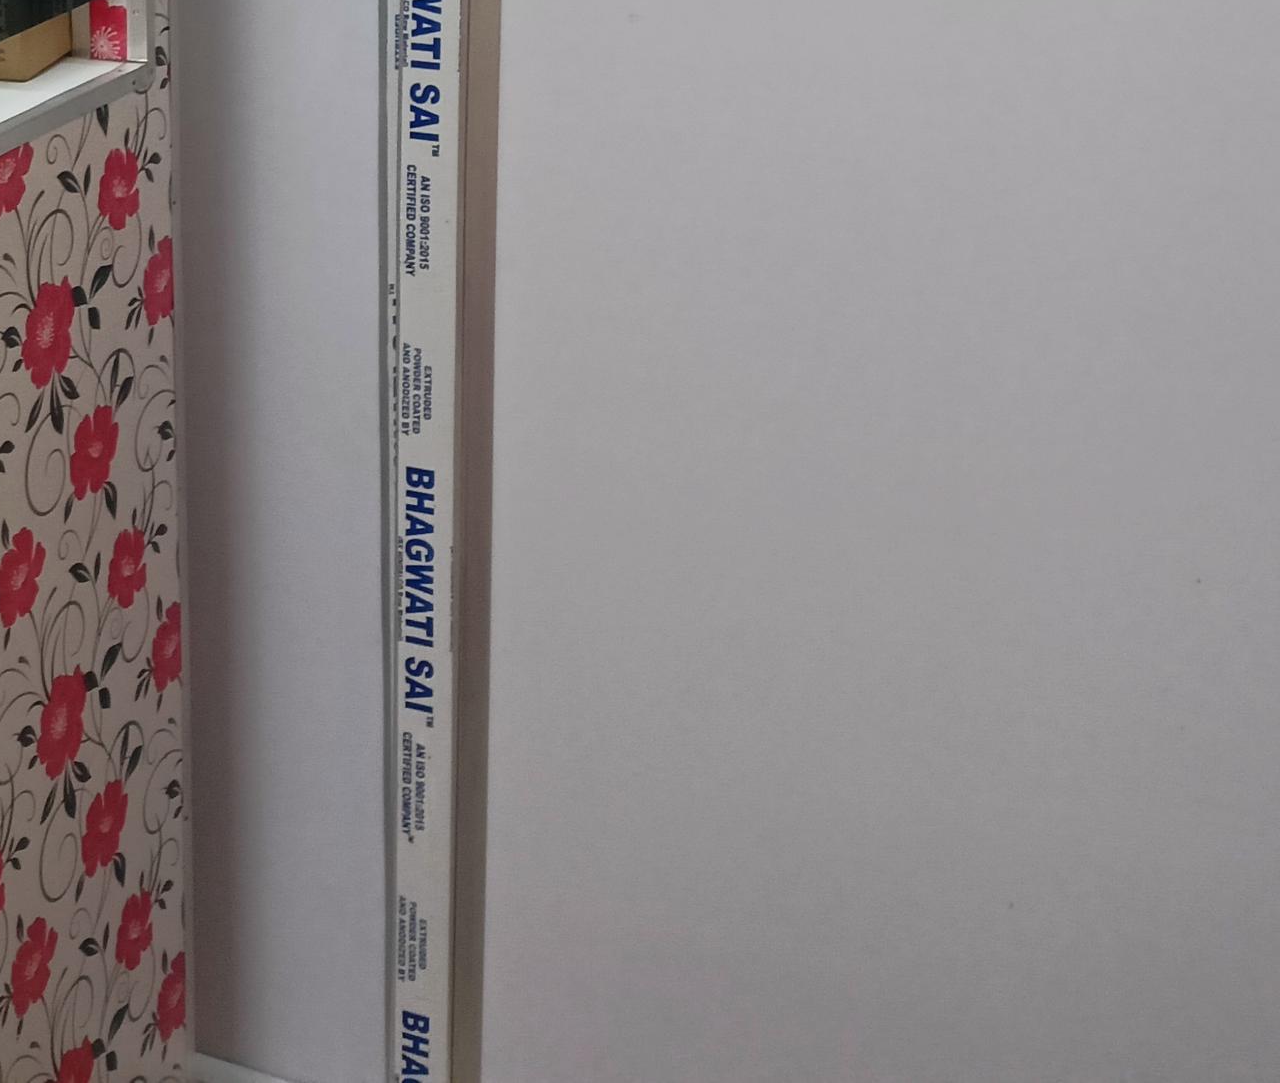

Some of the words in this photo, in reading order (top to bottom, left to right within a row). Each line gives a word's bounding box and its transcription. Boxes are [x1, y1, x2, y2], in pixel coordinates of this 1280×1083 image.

[406, 165, 417, 221] CERTIFIED
[419, 194, 430, 213] ISO
[420, 176, 430, 191] AN
[404, 224, 417, 276] COMPANY
[419, 216, 430, 270] 9001:2015
[402, 343, 411, 364] AND
[412, 348, 422, 391] POWDER
[401, 367, 410, 419] ANODIZED
[412, 394, 422, 434] COATED
[423, 366, 432, 420] EXTRUDED
[401, 422, 410, 435] BY
[405, 466, 436, 648] BHAGWATI
[402, 732, 412, 784] CERTIFIED
[415, 760, 426, 778] ISO
[416, 743, 426, 758] AN
